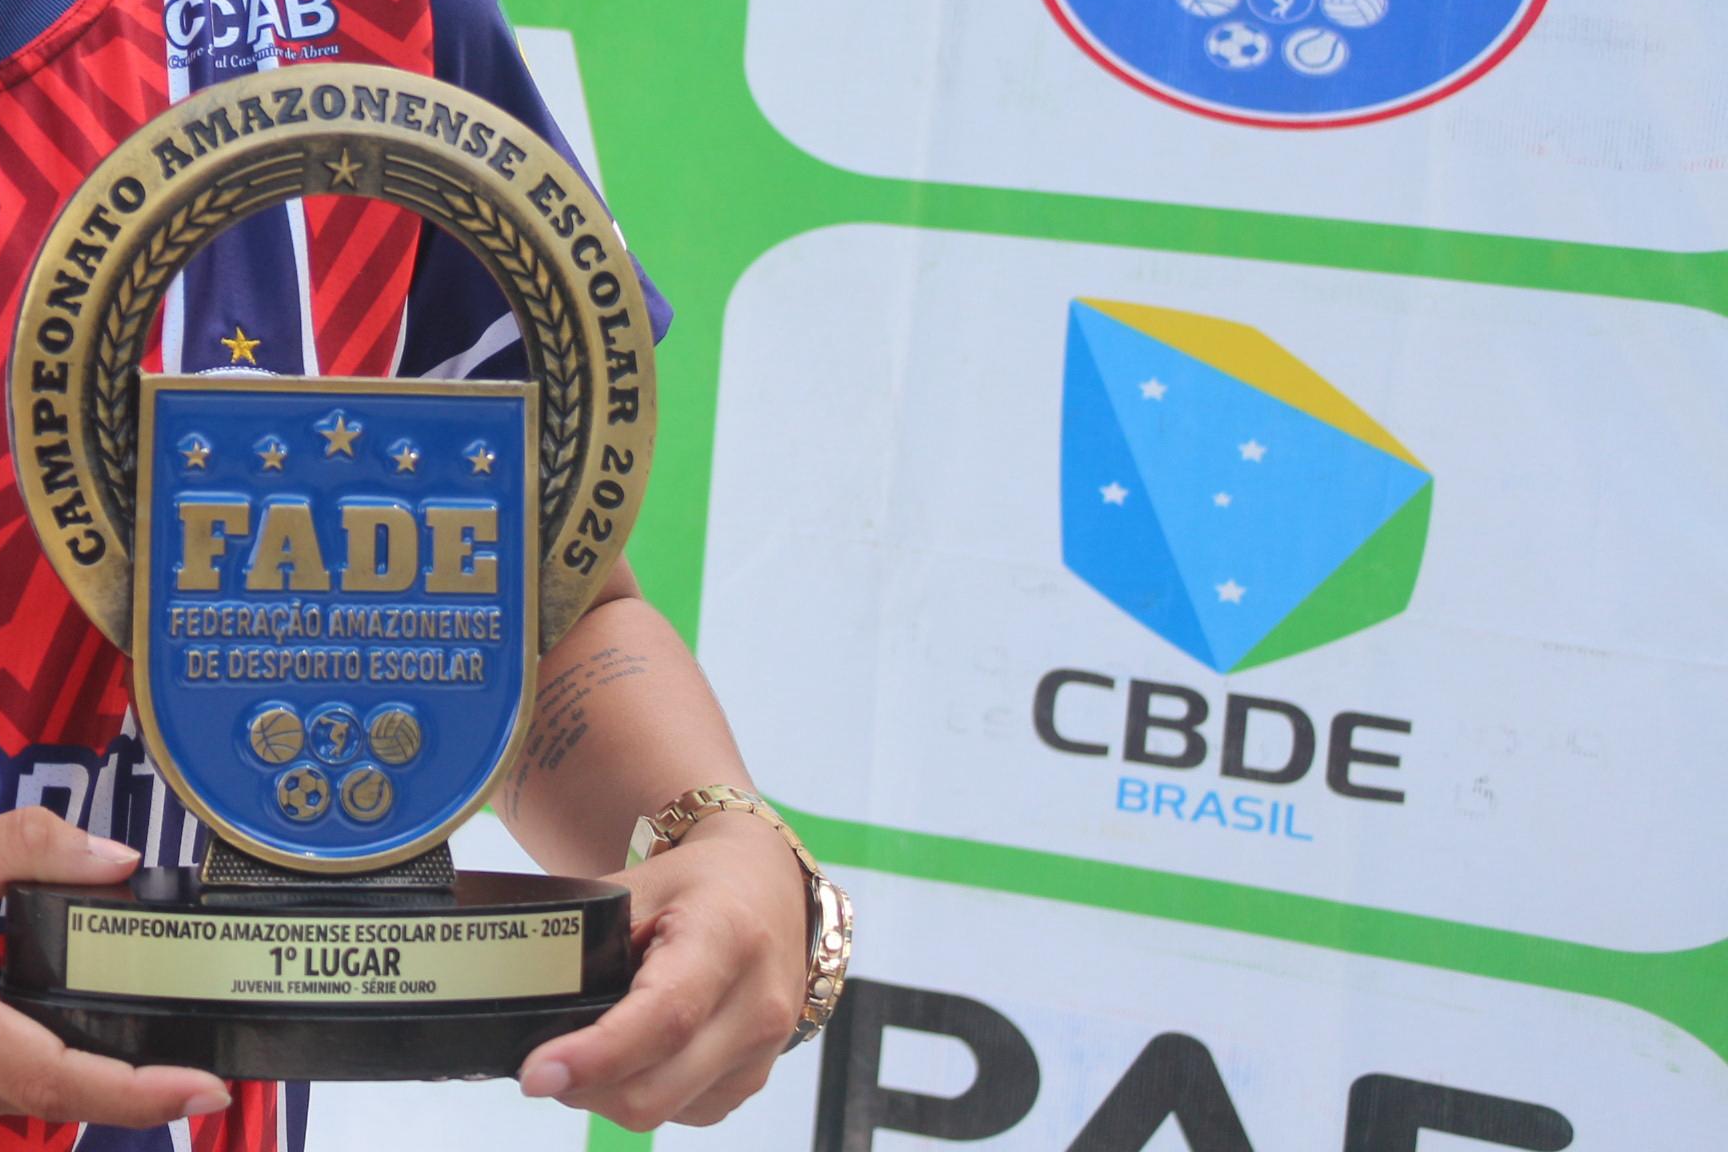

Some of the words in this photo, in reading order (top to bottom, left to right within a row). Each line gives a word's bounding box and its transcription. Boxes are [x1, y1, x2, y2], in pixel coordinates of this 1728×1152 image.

[299, 43, 340, 61] Abreu
[153, 85, 526, 182] AMAZONENSE
[529, 174, 639, 426] ESCOLAR
[31, 178, 145, 566] CAMPEONATO
[564, 450, 633, 577] 2025
[176, 501, 498, 594] FADE
[170, 602, 322, 644] FEDERAÇÃO
[329, 607, 501, 641] AMAZONENSE
[187, 650, 219, 680] DE
[228, 650, 361, 681] DESPORTO
[371, 651, 484, 683] ESCOLAR
[1032, 667, 1412, 804] CBDE
[1115, 776, 1314, 840] BRASIL
[72, 914, 83, 932] II
[87, 914, 217, 941] CAMPEONATO
[219, 922, 351, 943] AMAZONENSE
[355, 923, 436, 943] ESCOLAR
[440, 922, 463, 941] DE
[467, 920, 528, 940] FUTSAL
[540, 916, 580, 937] 2025
[231, 979, 284, 995] JUVENIL
[287, 980, 352, 995] FEMININO
[362, 977, 396, 995] SÉRIE
[399, 980, 436, 995] OURO
[304, 947, 401, 978] LUGAR
